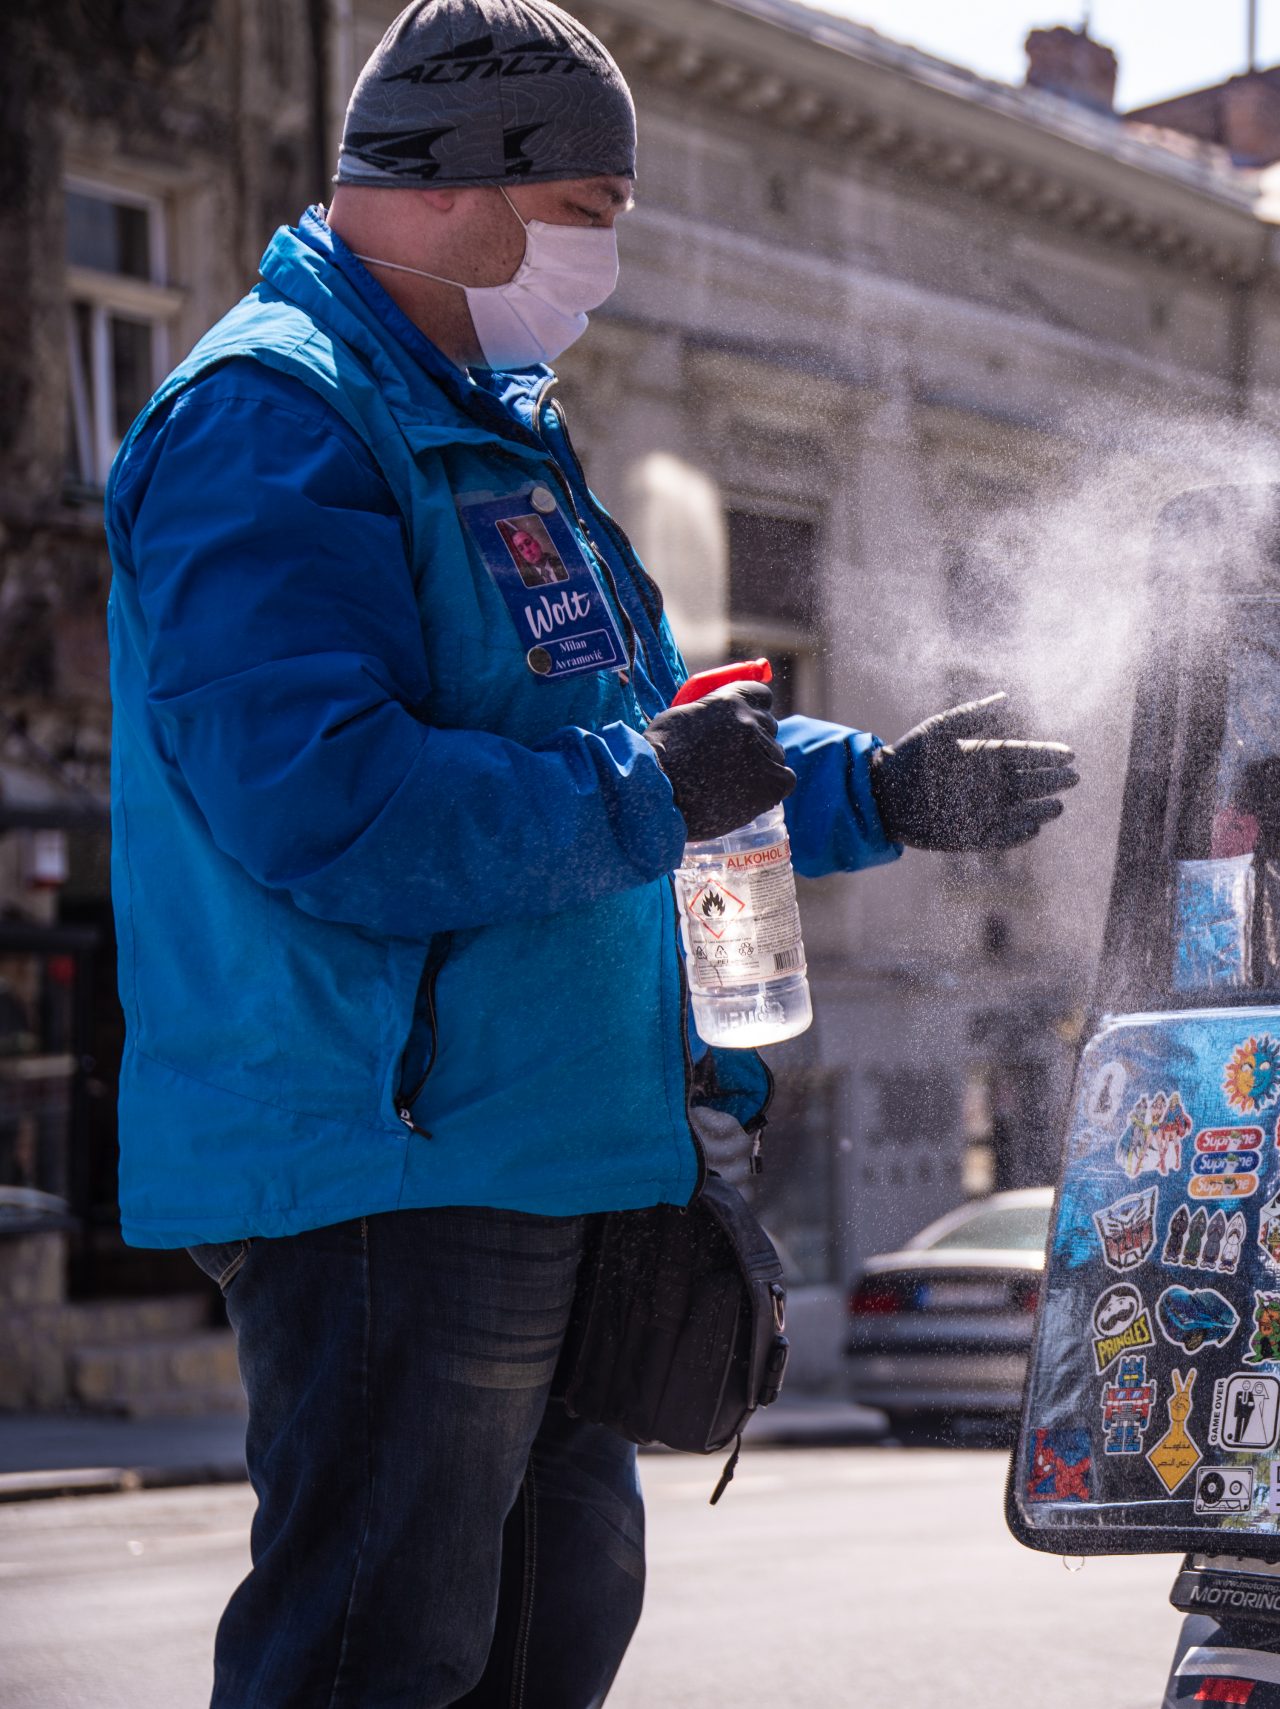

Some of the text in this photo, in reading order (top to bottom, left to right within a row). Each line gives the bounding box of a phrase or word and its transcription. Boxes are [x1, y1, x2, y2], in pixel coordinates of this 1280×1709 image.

[524, 591, 592, 639] Wolt
[560, 640, 587, 652] Milan
[556, 649, 604, 669] Avramović
[728, 848, 783, 869] ALKOHOL
[1210, 1381, 1225, 1442] GAME OVER
